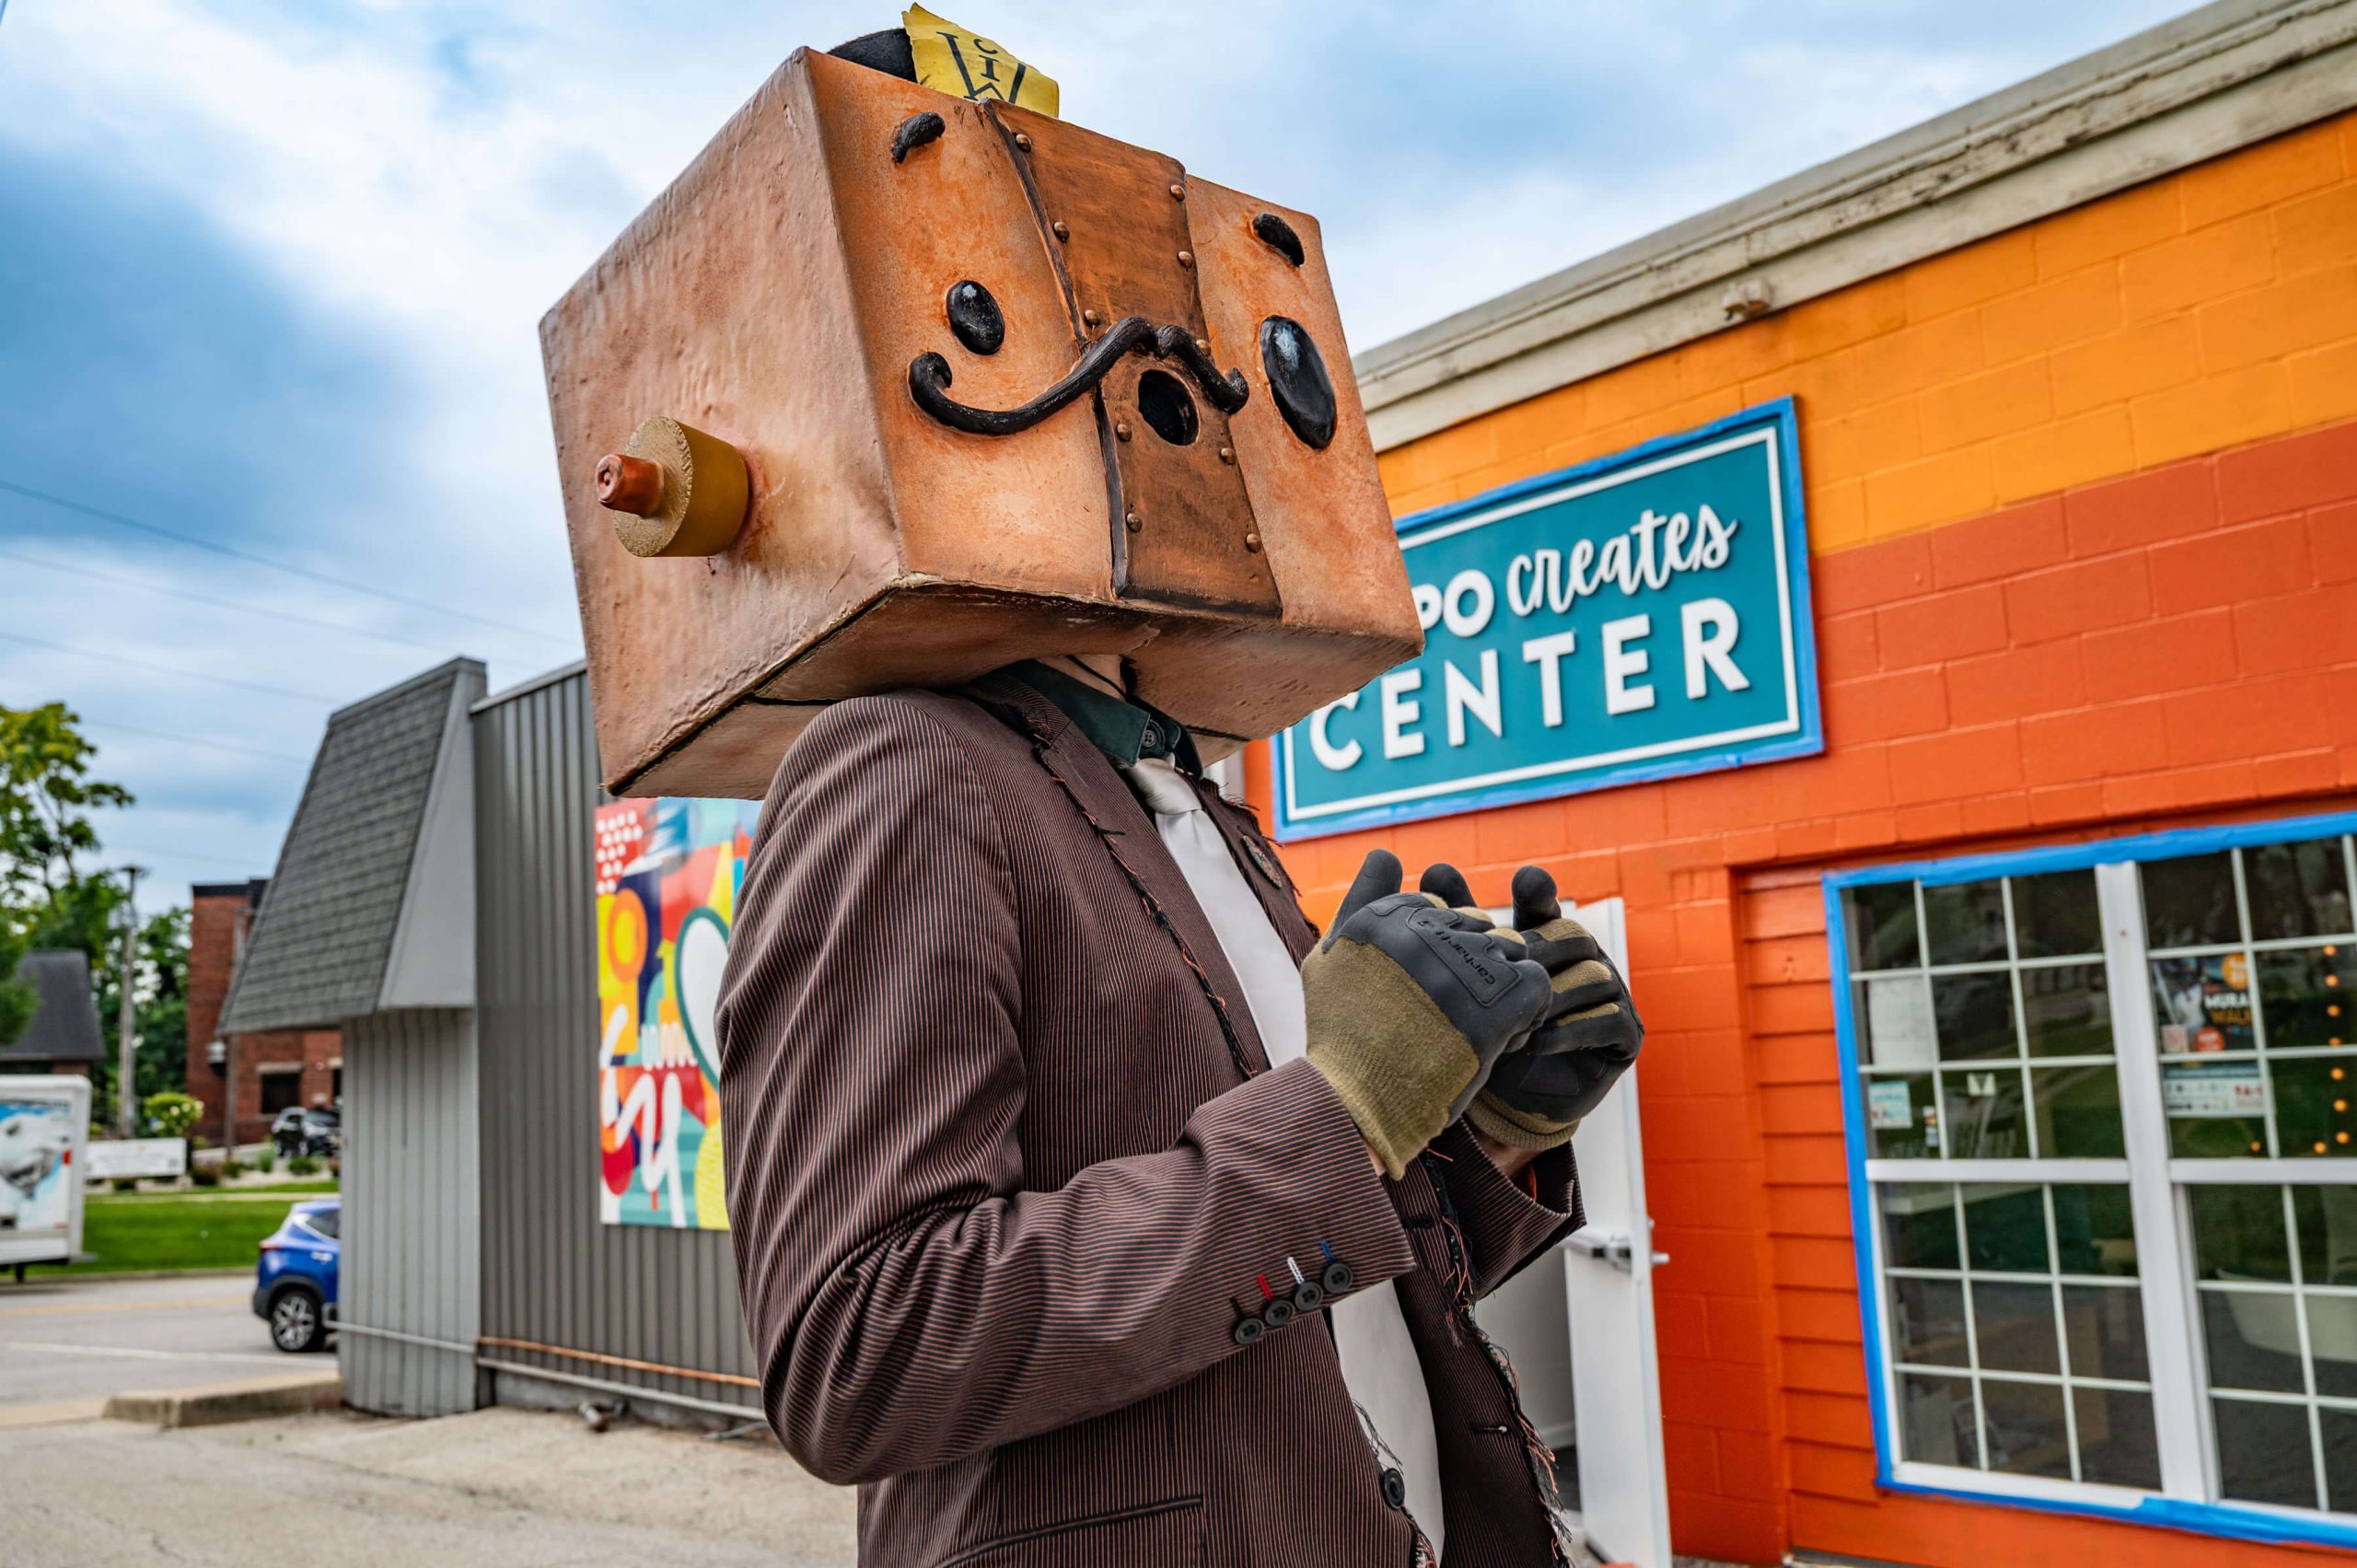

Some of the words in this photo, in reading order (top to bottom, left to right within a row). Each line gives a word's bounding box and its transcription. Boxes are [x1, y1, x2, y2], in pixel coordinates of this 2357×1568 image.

[1411, 569, 1495, 638] PO
[1506, 504, 1738, 616] creates
[1309, 597, 1750, 772] CENTER
